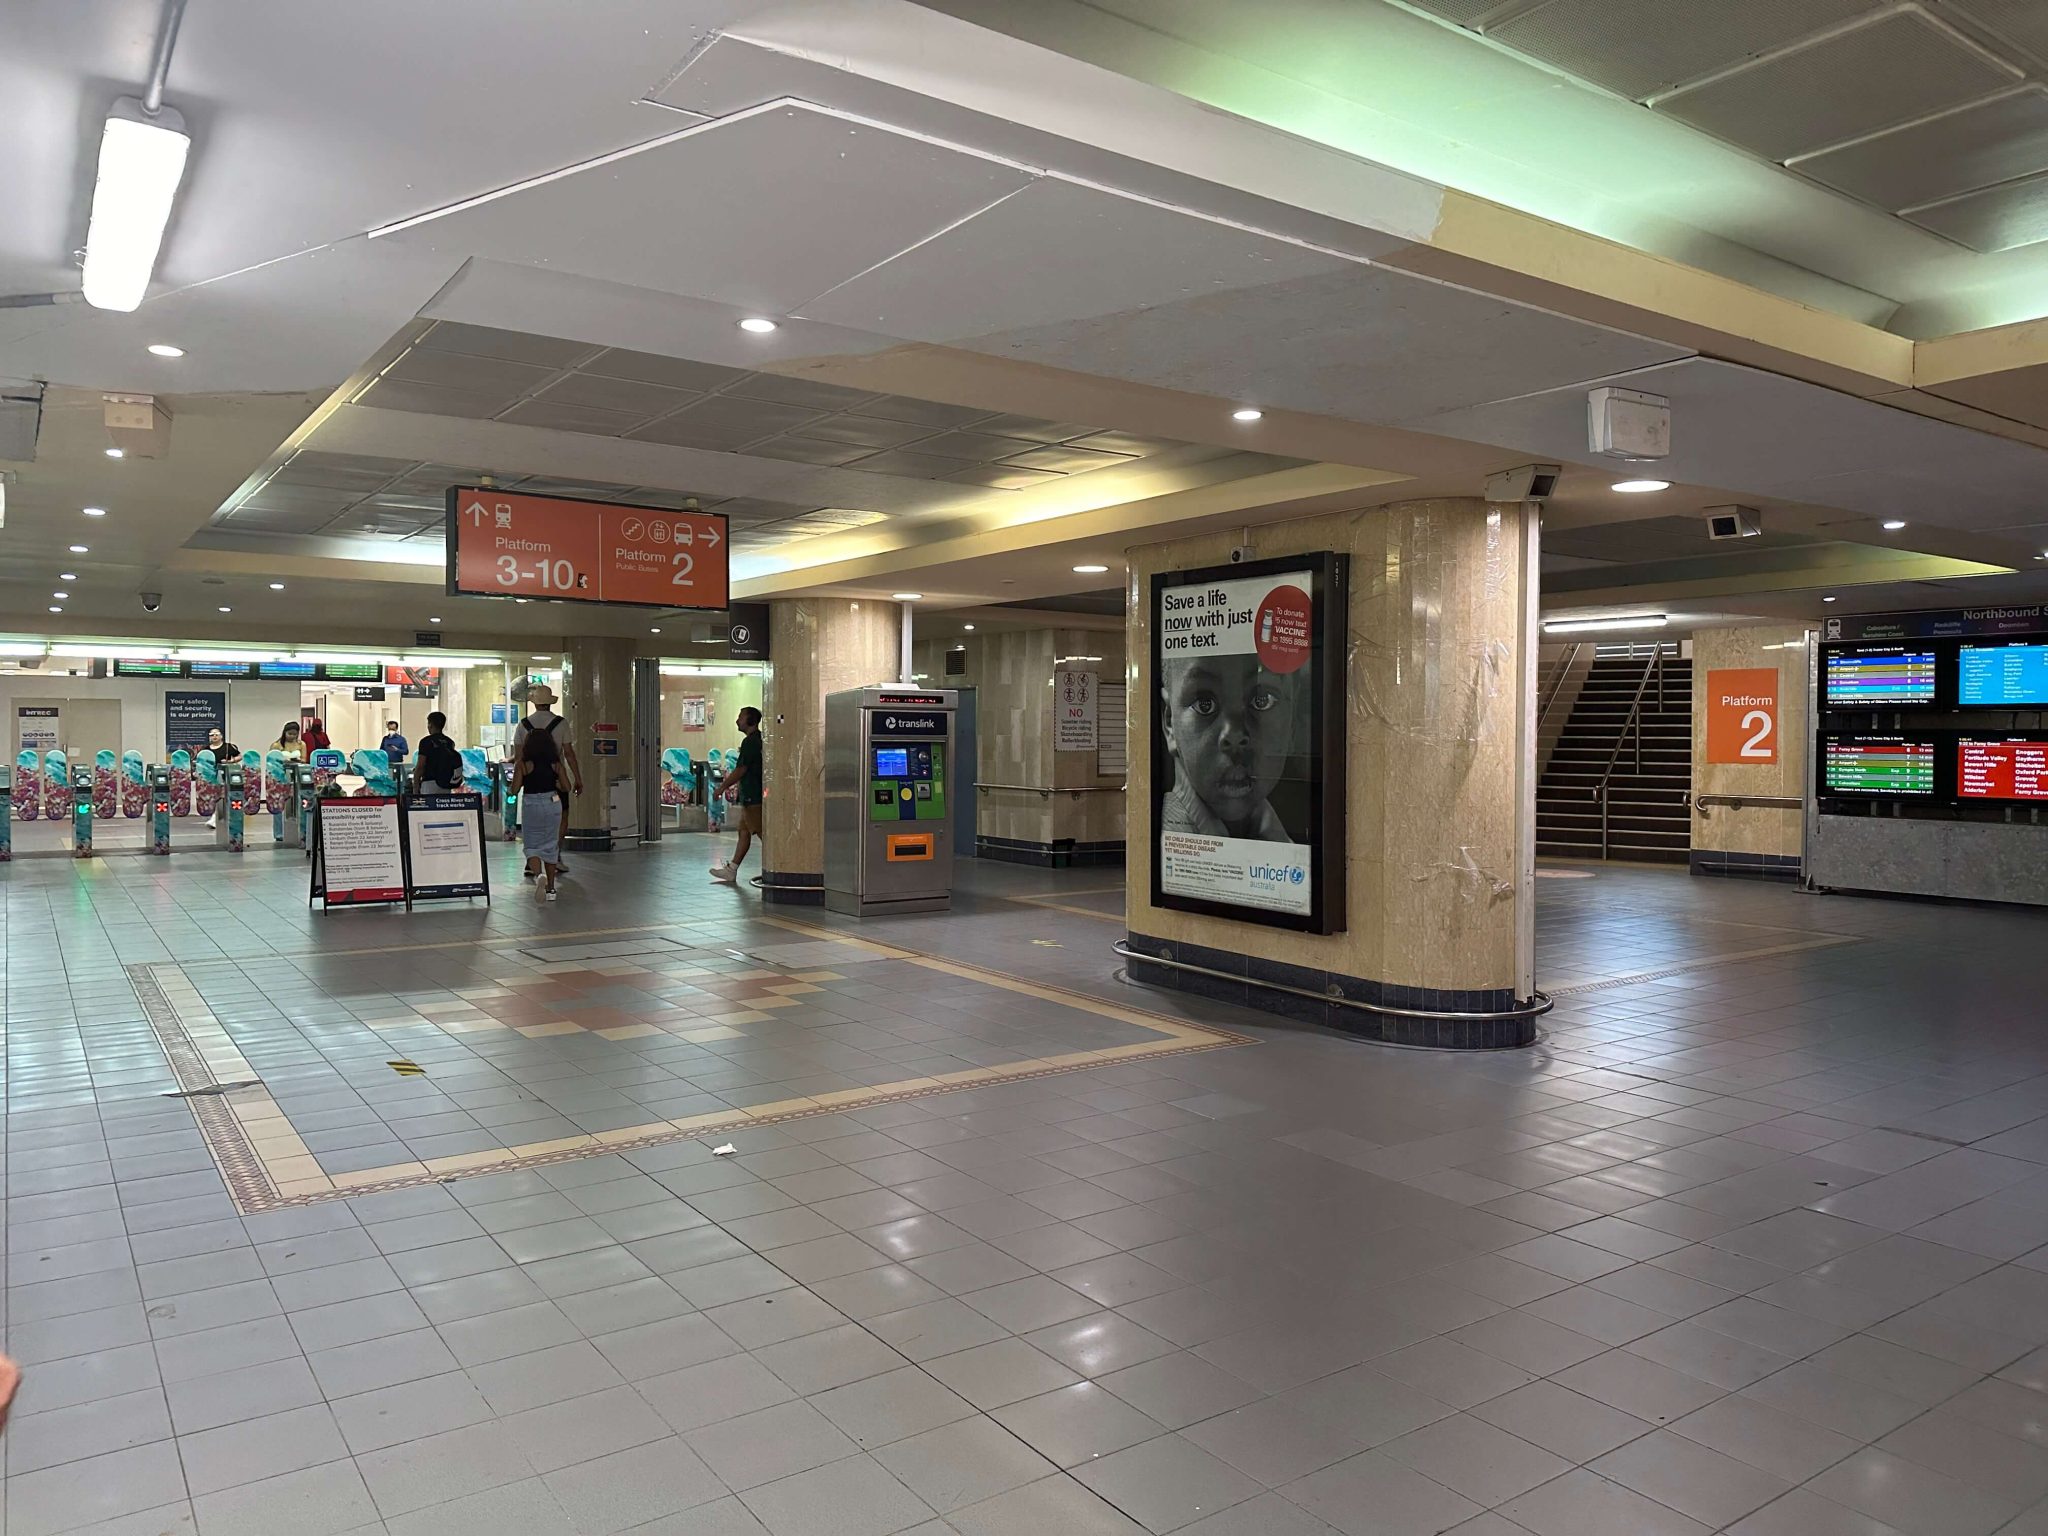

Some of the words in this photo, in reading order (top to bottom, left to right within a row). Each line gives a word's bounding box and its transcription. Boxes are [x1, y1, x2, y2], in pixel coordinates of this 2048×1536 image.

[495, 536, 551, 552] Platform
[615, 547, 666, 563] Platform
[496, 555, 574, 590] 3-10
[615, 562, 636, 572] Public
[638, 564, 659, 573] Buses
[671, 552, 694, 586] 2
[1164, 594, 1194, 611] Save
[1197, 597, 1205, 607] a
[1207, 589, 1227, 606] life
[1164, 616, 1193, 631] now
[1195, 610, 1224, 627] with
[1227, 608, 1253, 629] just
[1276, 606, 1283, 615] To
[1283, 608, 1304, 618] donate
[1963, 606, 2040, 620] Northbound
[1281, 618, 1294, 626] now
[1295, 620, 1306, 628] text
[1164, 635, 1188, 650] one
[1190, 632, 1219, 648] text.
[1721, 695, 1773, 706] Platform
[1069, 708, 1083, 718] NO
[898, 718, 935, 729] translink
[1740, 710, 1772, 757] 2
[1249, 863, 1290, 882] unicef
[1249, 882, 1276, 891] australia
